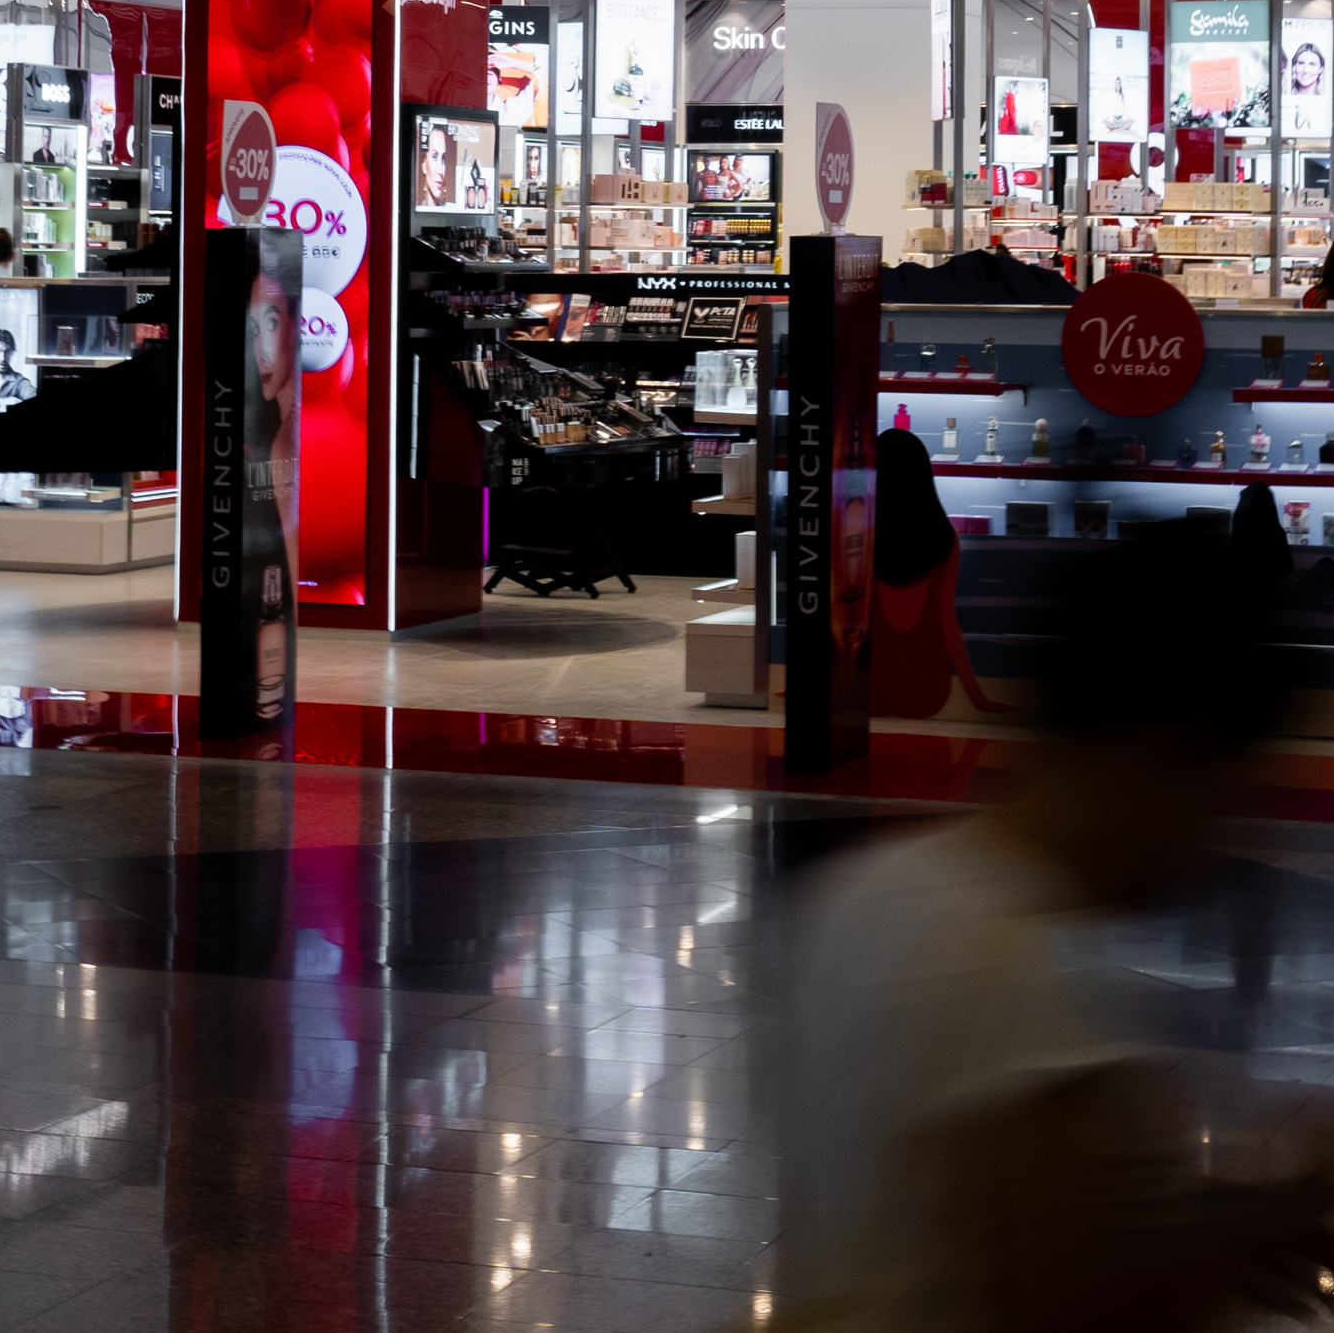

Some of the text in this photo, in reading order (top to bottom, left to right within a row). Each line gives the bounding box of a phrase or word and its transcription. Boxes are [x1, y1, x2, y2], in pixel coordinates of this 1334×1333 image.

[1189, 4, 1250, 37] gamila
[712, 25, 765, 51] Skin
[41, 82, 71, 103] BOSS
[733, 118, 764, 130] ESTÉE
[229, 148, 270, 181] -30%
[821, 152, 851, 186] -30%
[637, 277, 677, 290] NYX
[689, 280, 778, 289] PROFESSIONAL
[1080, 314, 1185, 360] Viva
[1094, 361, 1171, 376] O VERÃO
[211, 378, 234, 589] GIVENCHY
[797, 393, 821, 615] GIVENCHY
